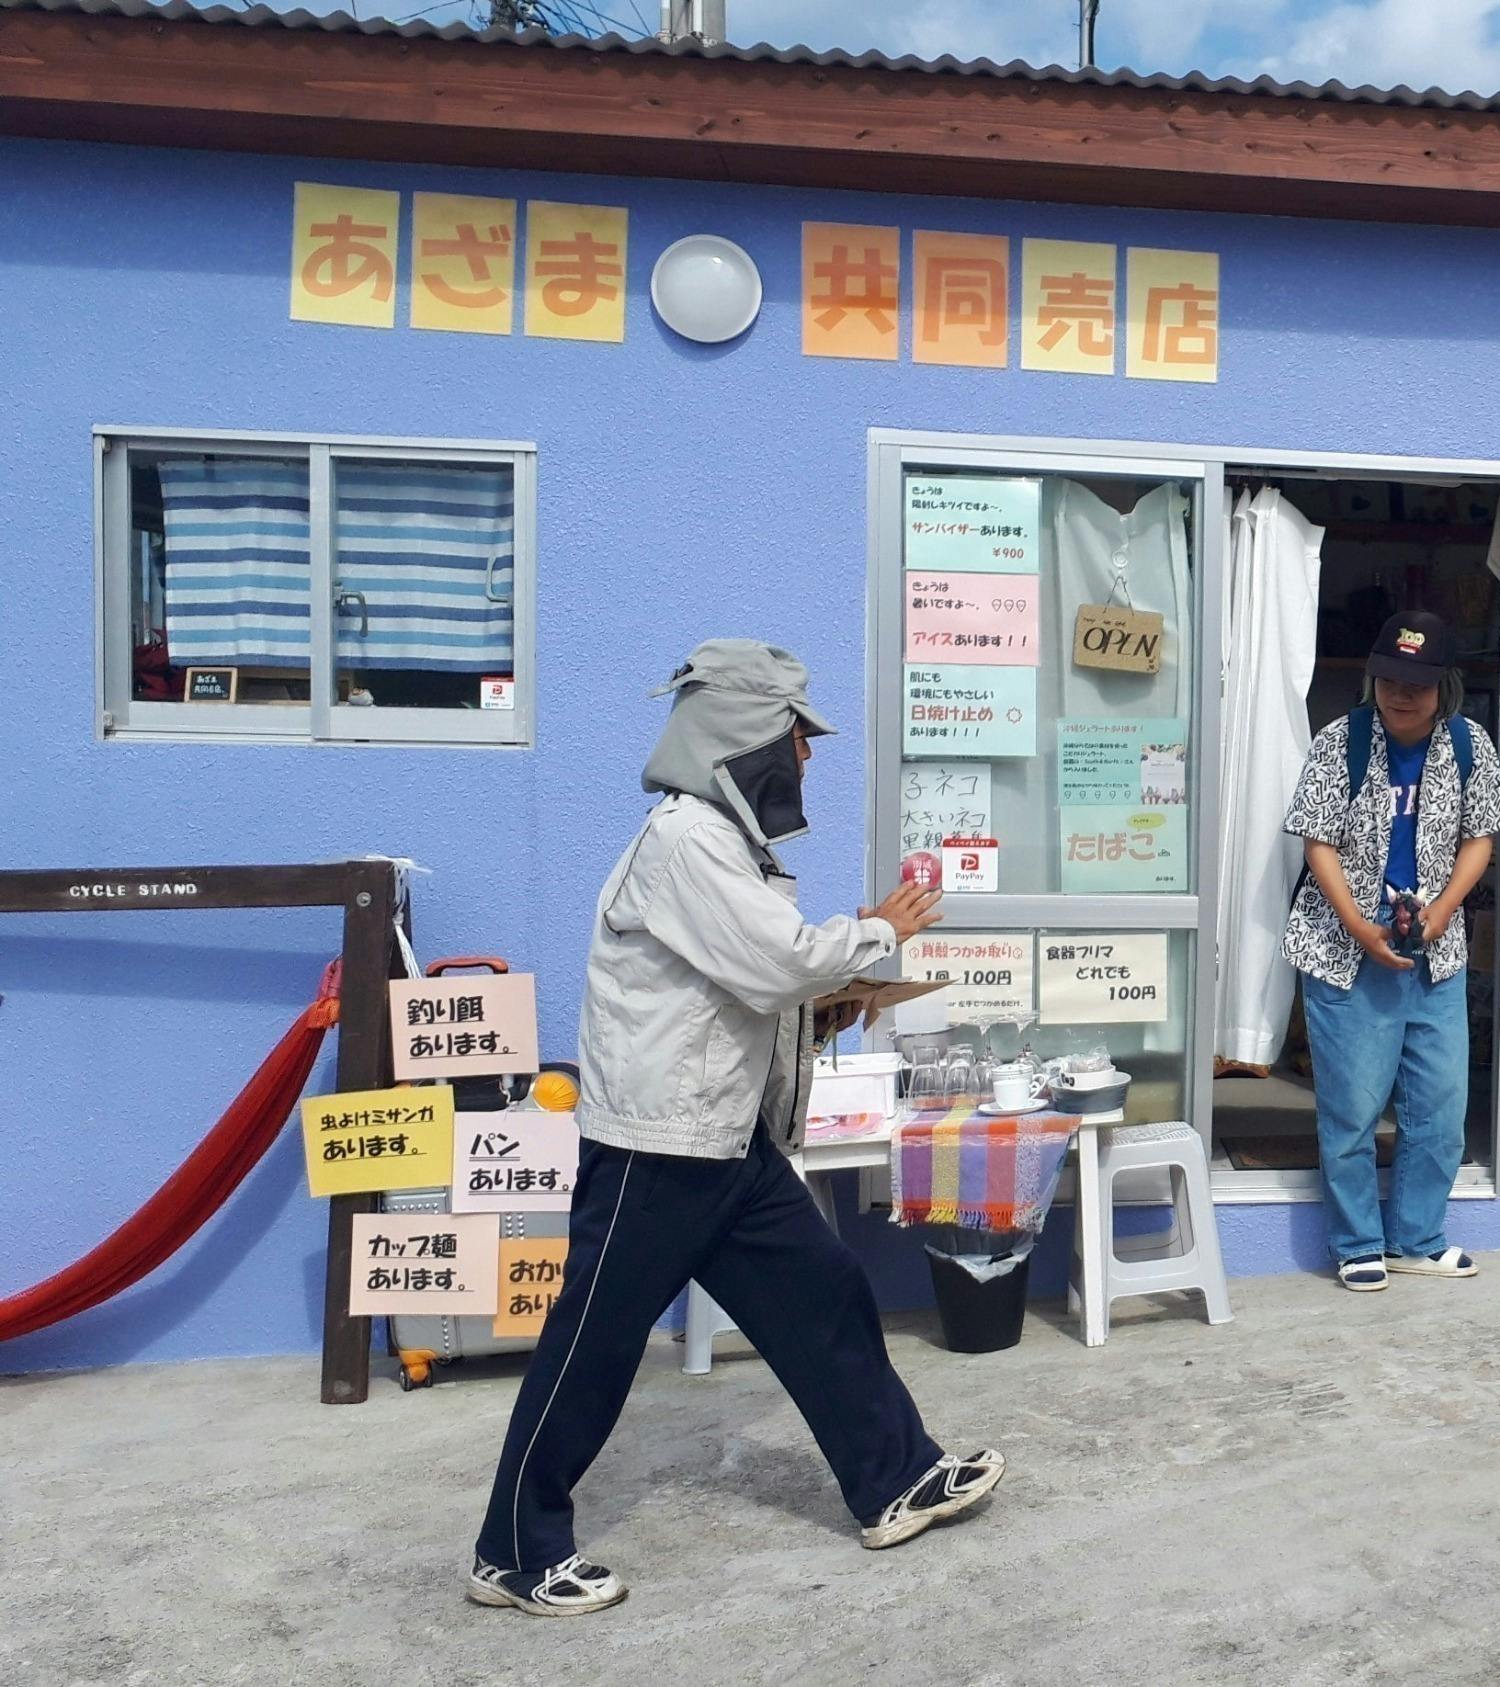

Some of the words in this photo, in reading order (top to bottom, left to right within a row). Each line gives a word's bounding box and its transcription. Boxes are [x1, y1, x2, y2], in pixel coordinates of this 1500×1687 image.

[300, 213, 624, 316] あざま
[810, 245, 1217, 366] 共同売店
[911, 486, 943, 496] きょうは
[912, 581, 949, 592] きょうは
[1082, 626, 1159, 658] OPEN
[909, 671, 942, 683] 肌にも
[909, 688, 995, 700] 環境にもやさしい
[911, 704, 994, 721] 日焼け止め
[904, 768, 979, 800] 子ネコ
[900, 806, 987, 828] 大きいネコ
[1067, 832, 1156, 862] たばこ
[955, 872, 984, 881] PayPay
[69, 884, 127, 897] CYCLE
[138, 883, 198, 896] STAND
[1046, 945, 1114, 961] 食器フリマ
[963, 970, 1012, 985] 100円
[1075, 966, 1131, 980] どれでも
[1109, 985, 1156, 1001] 100円
[408, 995, 485, 1025] 釣り餌
[409, 1030, 511, 1057] あります。
[320, 1105, 435, 1131] 虫よけミサンガ
[322, 1134, 419, 1162] あります。
[469, 1132, 521, 1157] パン
[468, 1168, 570, 1192] あります。
[368, 1233, 458, 1259] カップ麺
[367, 1267, 466, 1292] あります。
[509, 1293, 560, 1316] あり
